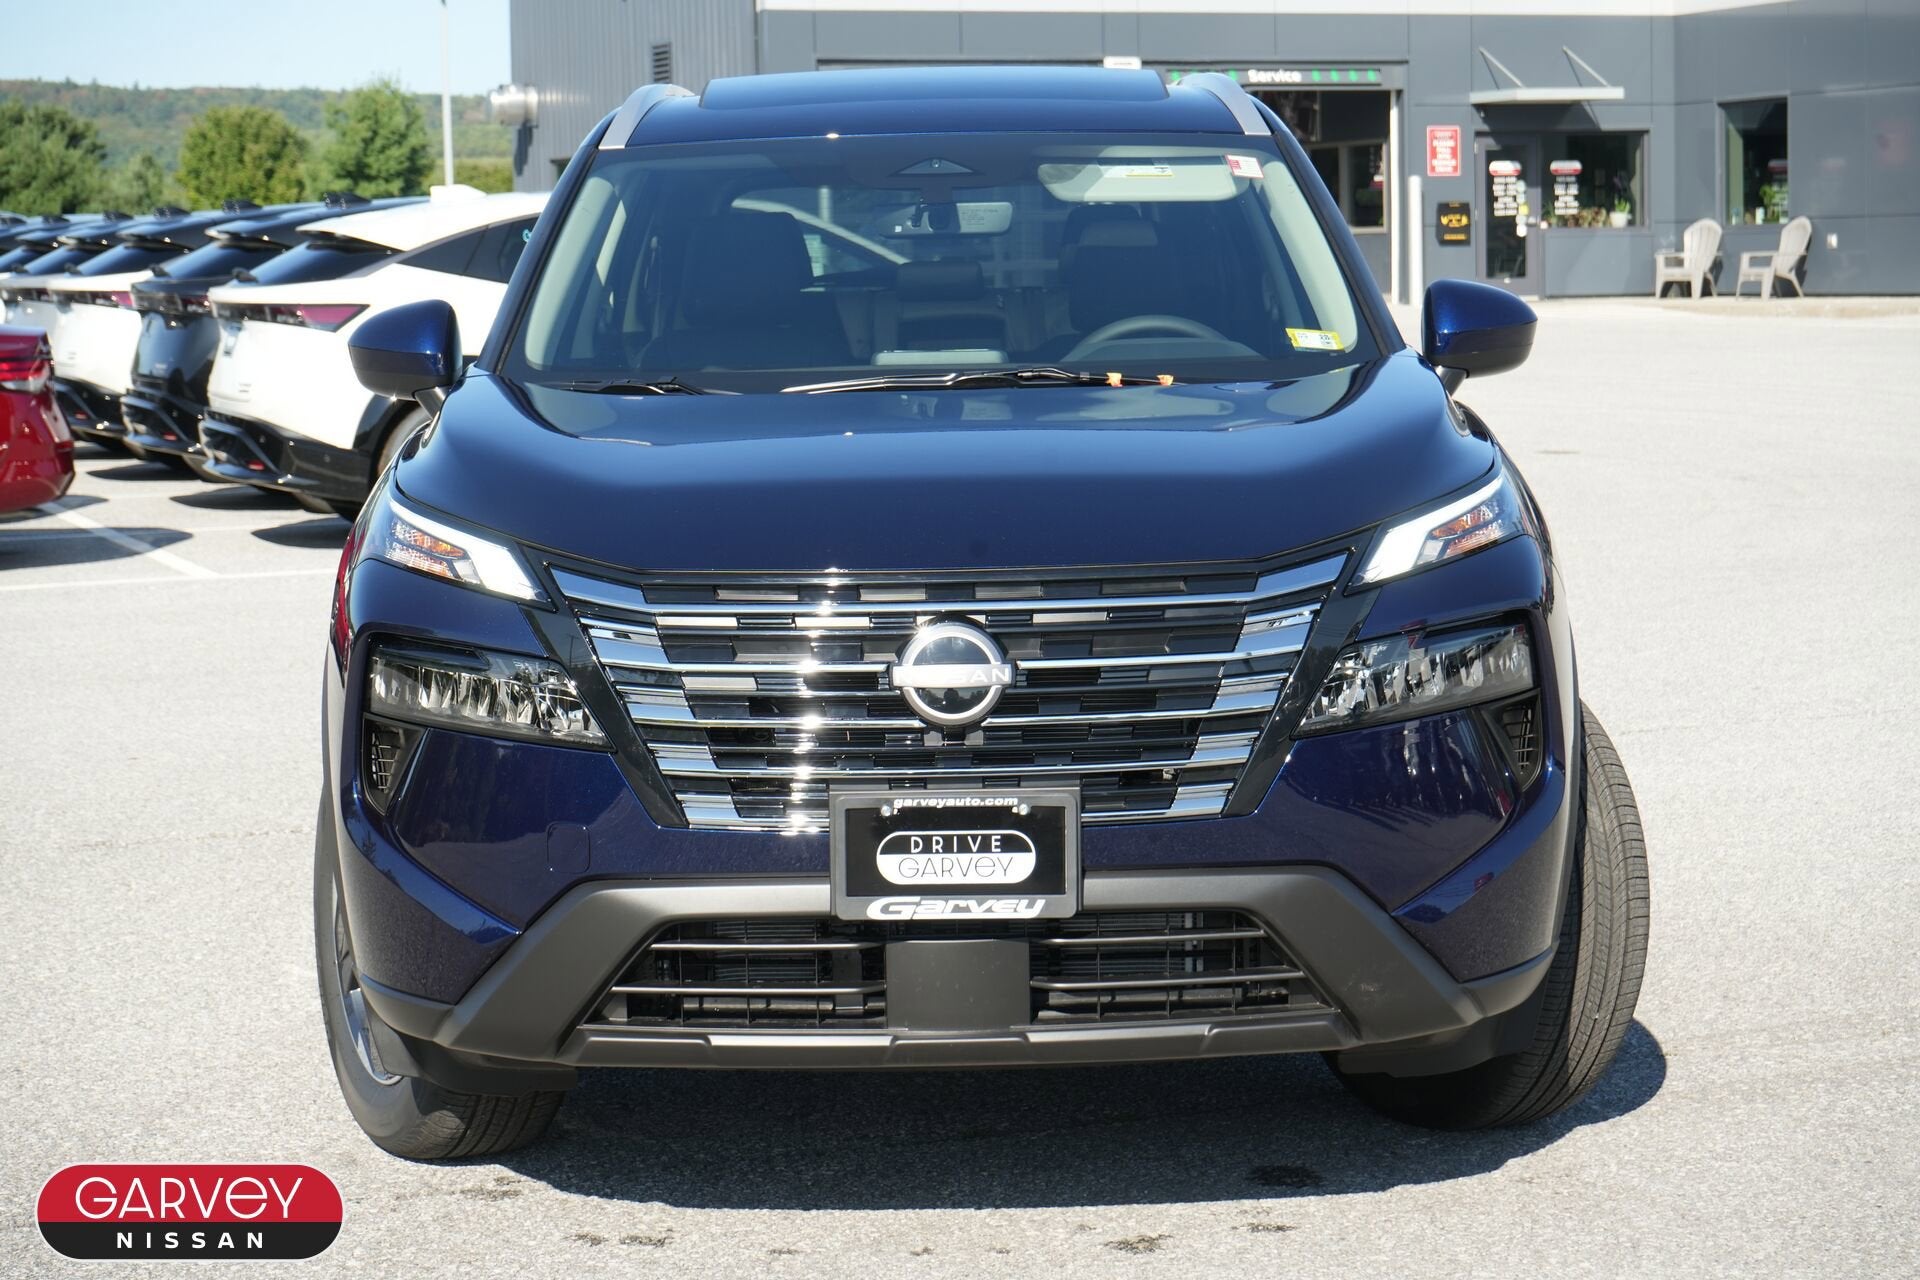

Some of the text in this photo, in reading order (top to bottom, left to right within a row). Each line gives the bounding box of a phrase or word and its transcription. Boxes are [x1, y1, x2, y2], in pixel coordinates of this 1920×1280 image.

[1247, 69, 1302, 83] Service
[893, 797, 1018, 809] garveyauto.com
[910, 835, 1002, 853] DRIVE
